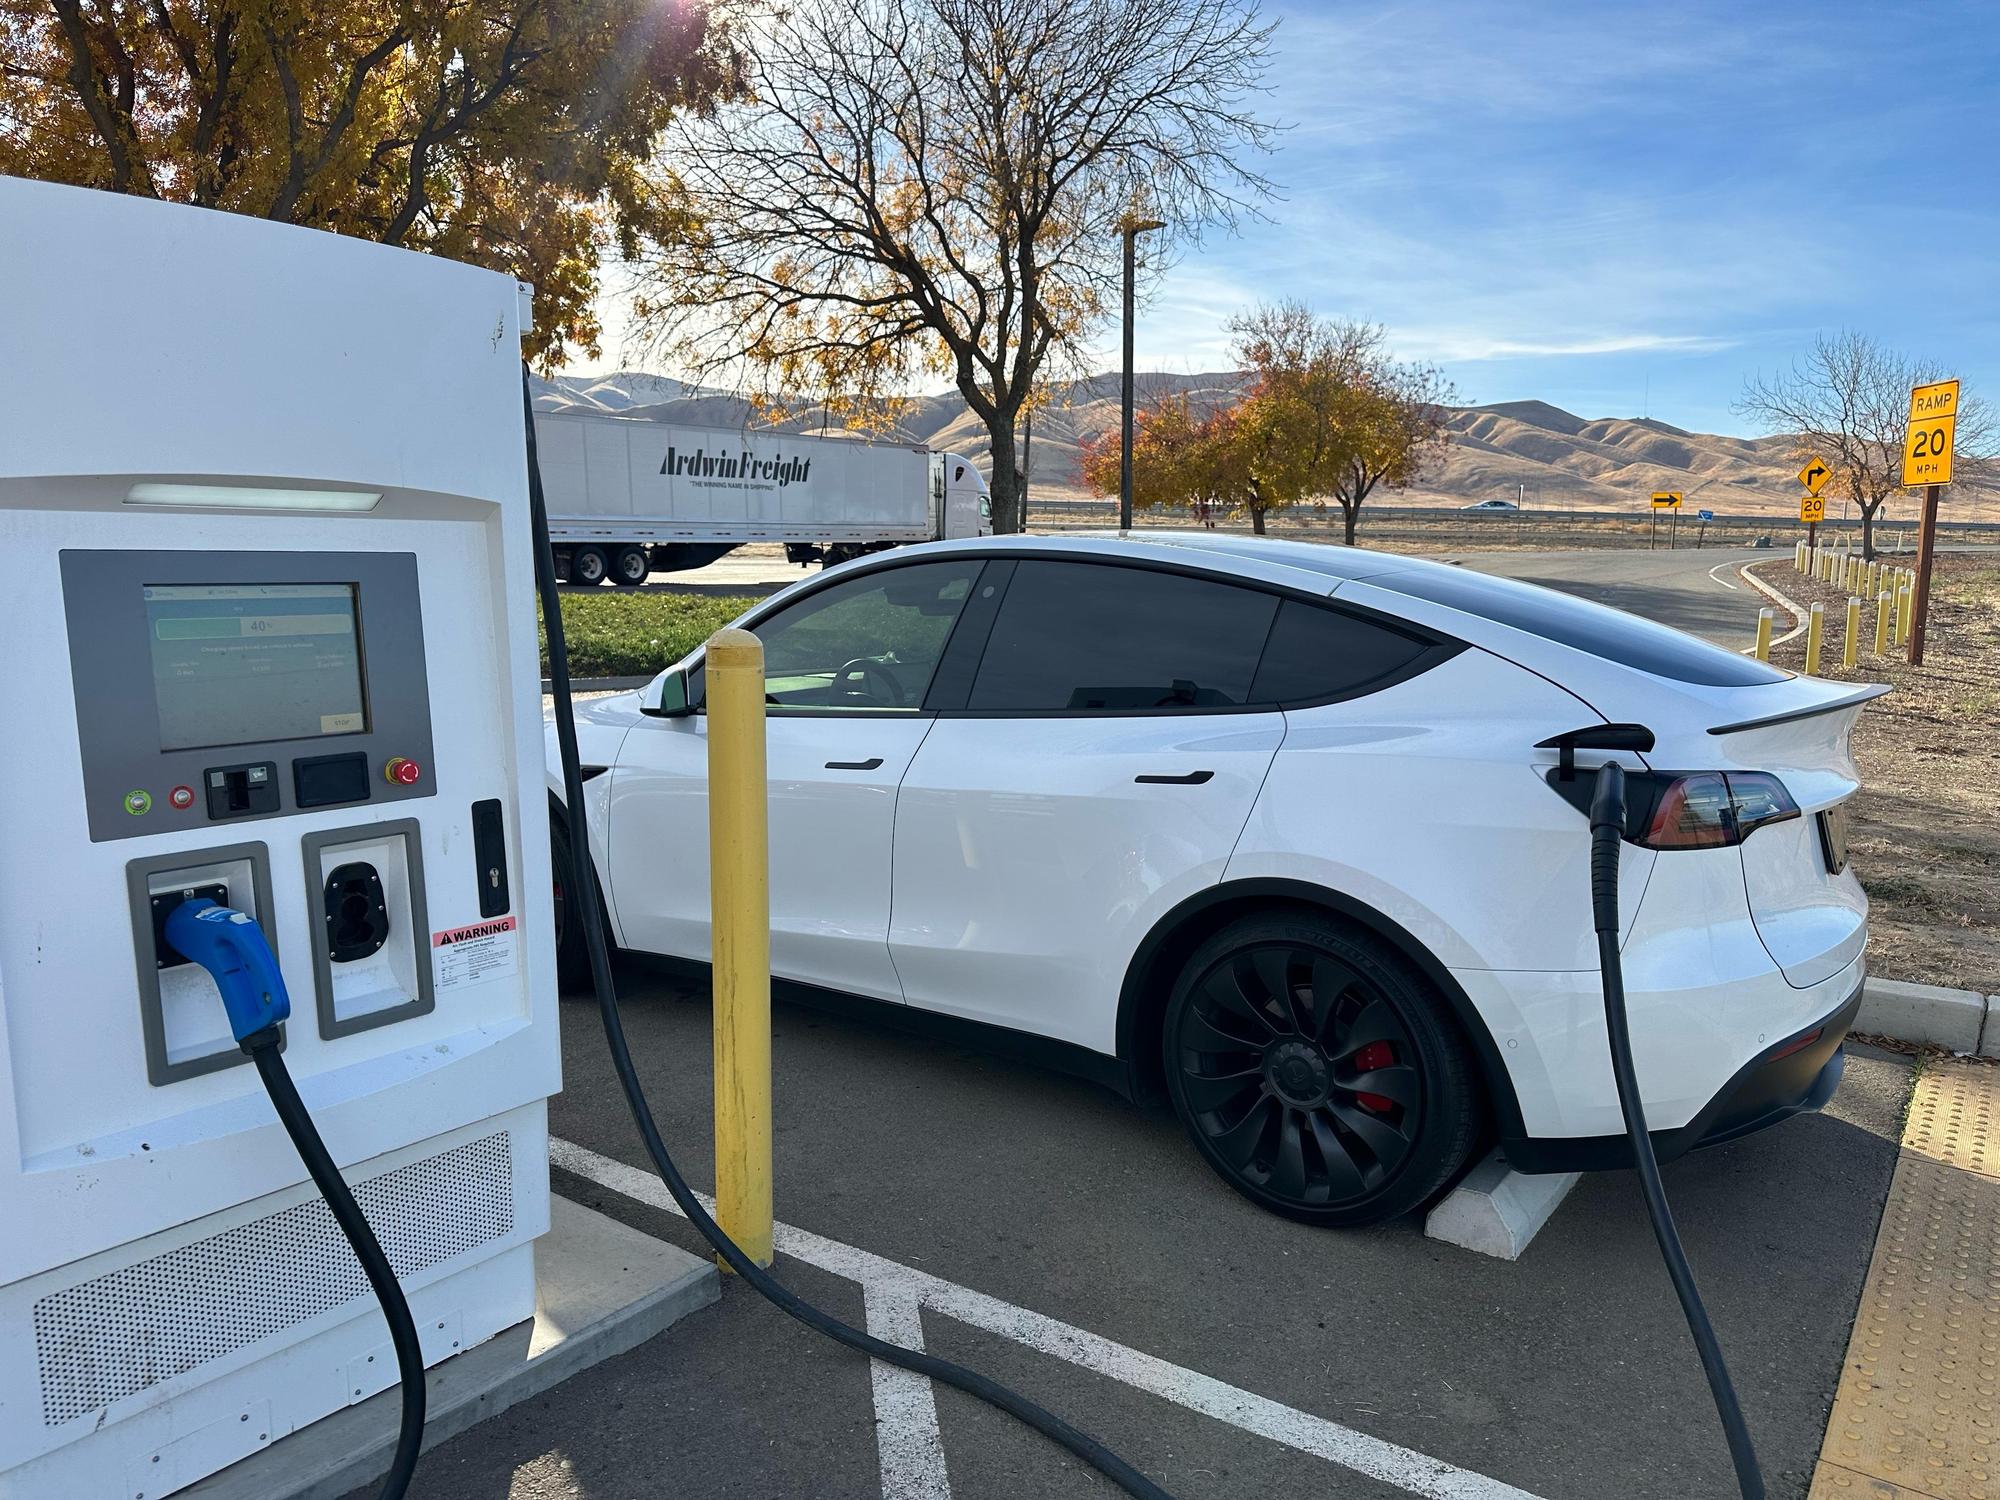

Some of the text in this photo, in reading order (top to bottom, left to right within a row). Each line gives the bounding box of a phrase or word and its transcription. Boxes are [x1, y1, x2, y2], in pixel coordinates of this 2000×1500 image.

[1916, 392, 1952, 412] RAMP
[1912, 428, 1945, 458] 20
[1916, 463, 1938, 474] MPH
[703, 481, 727, 489] WINNING
[727, 482, 743, 490] NAME
[1804, 500, 1822, 511] 20
[453, 921, 510, 942] WARNING
